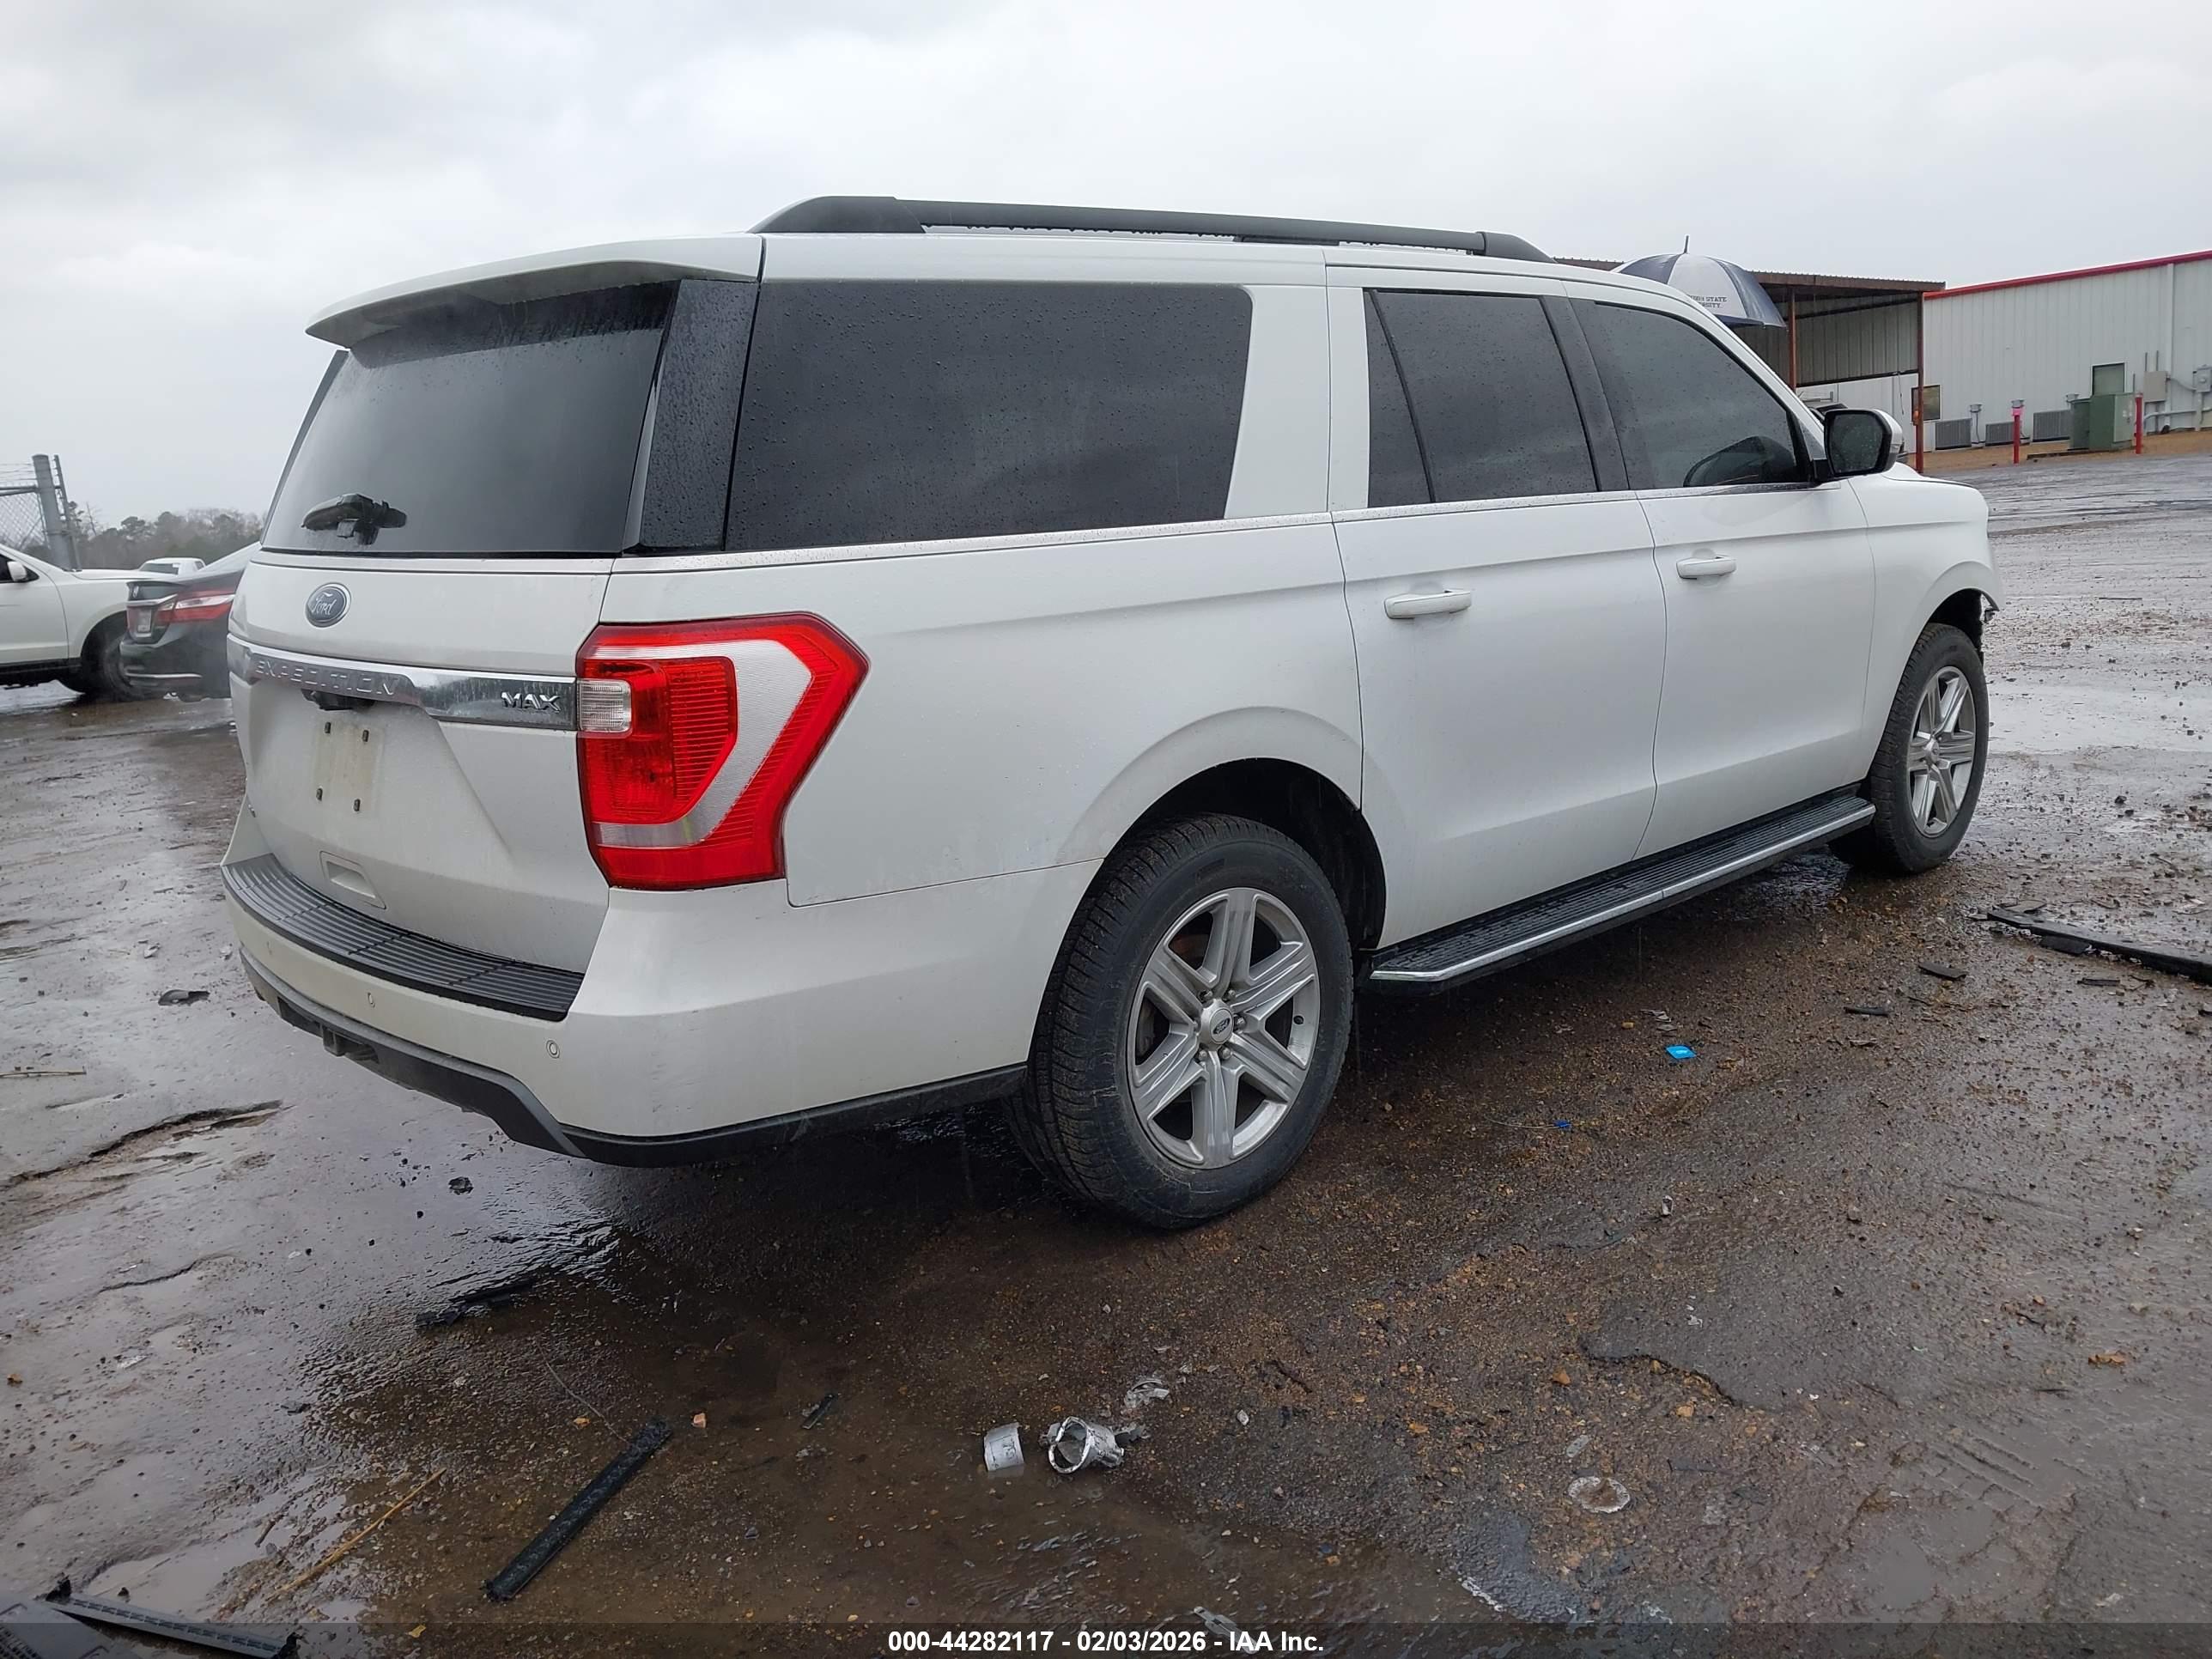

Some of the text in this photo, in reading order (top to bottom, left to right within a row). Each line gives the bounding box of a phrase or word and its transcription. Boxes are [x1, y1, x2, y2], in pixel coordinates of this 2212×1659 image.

[311, 592, 337, 616] Ford
[255, 659, 562, 711] EXPEDITION MAX
